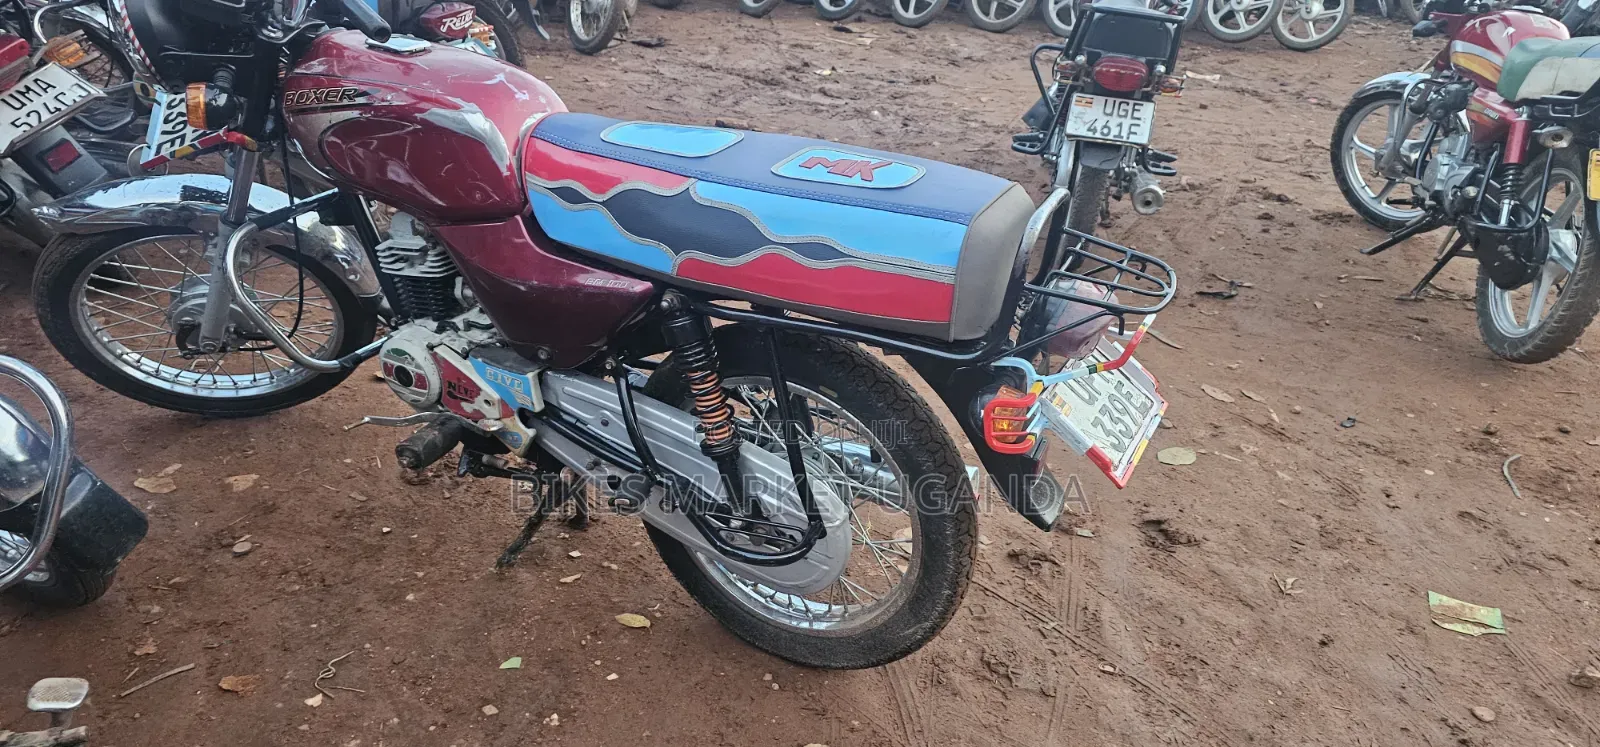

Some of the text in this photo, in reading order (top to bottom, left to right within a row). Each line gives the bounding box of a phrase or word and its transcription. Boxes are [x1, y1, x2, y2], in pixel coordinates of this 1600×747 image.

[1, 78, 57, 111] UMA
[284, 86, 358, 106] BOXER
[1103, 98, 1144, 120] UGE
[1086, 118, 1141, 140] 461F
[799, 156, 893, 182] MK
[1091, 380, 1152, 453] 339E
